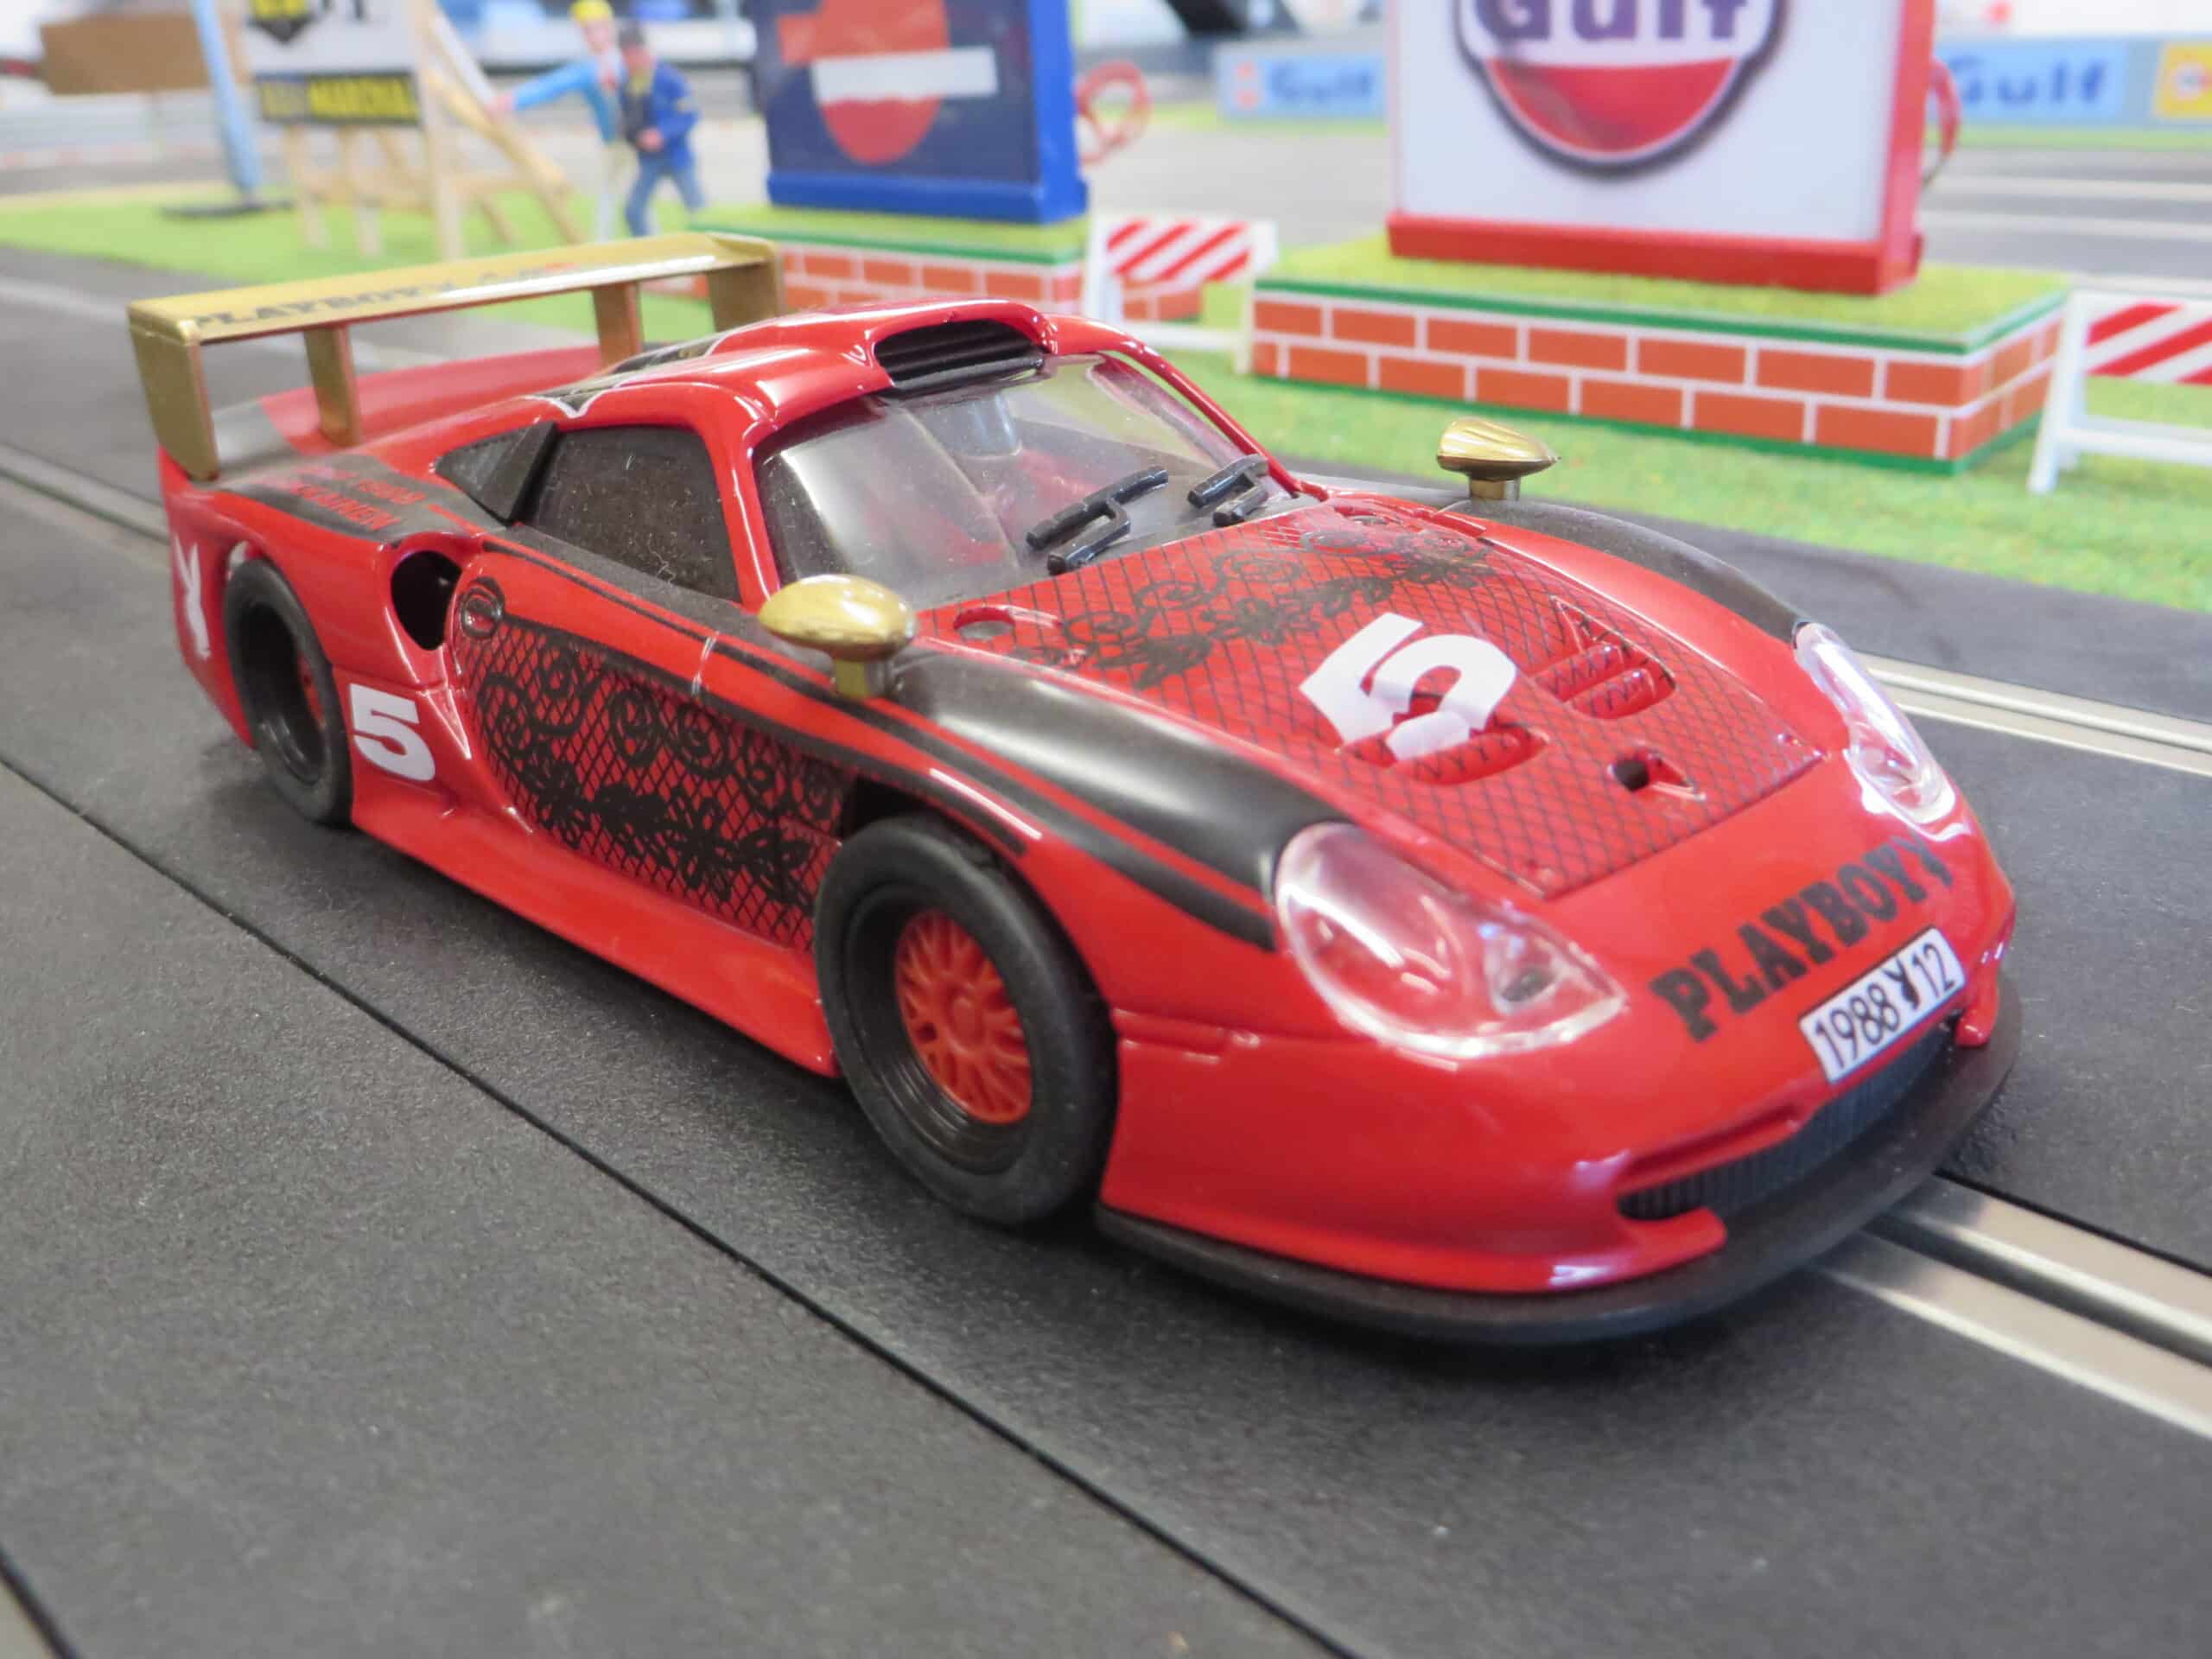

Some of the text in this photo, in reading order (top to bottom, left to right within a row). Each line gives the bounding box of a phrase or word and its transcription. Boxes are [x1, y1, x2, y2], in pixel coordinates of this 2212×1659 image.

[349, 683, 435, 781] 5
[1298, 612, 1516, 762] 5
[1649, 843, 1928, 1043] PLAYBOY
[1815, 943, 1955, 1069] 1988 12
